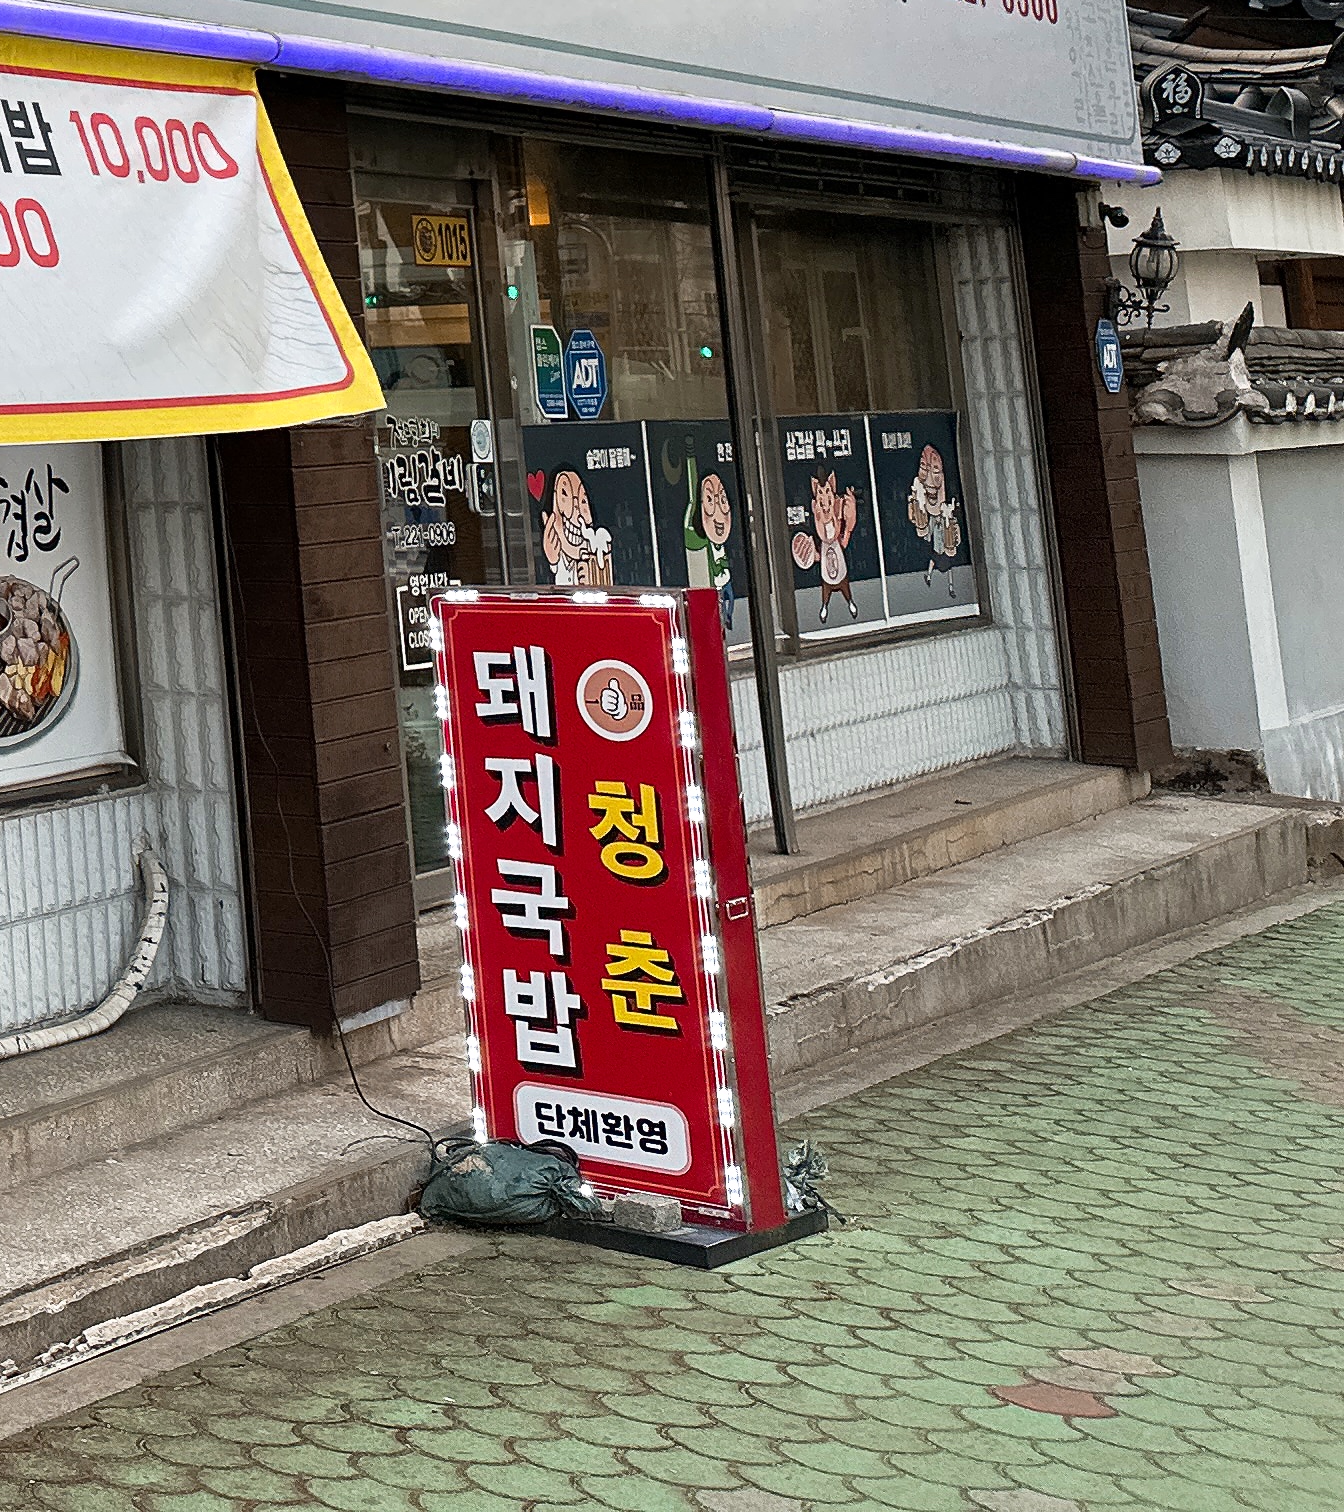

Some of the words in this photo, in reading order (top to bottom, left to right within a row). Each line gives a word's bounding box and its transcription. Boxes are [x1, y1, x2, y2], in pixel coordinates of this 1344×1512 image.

[1161, 71, 1193, 103] 福
[438, 222, 468, 261] 1015
[573, 358, 599, 388] ADT
[472, 645, 586, 1071] 돼지국밥
[588, 780, 683, 1034] 청춘
[534, 1100, 668, 1157] 단체환영
